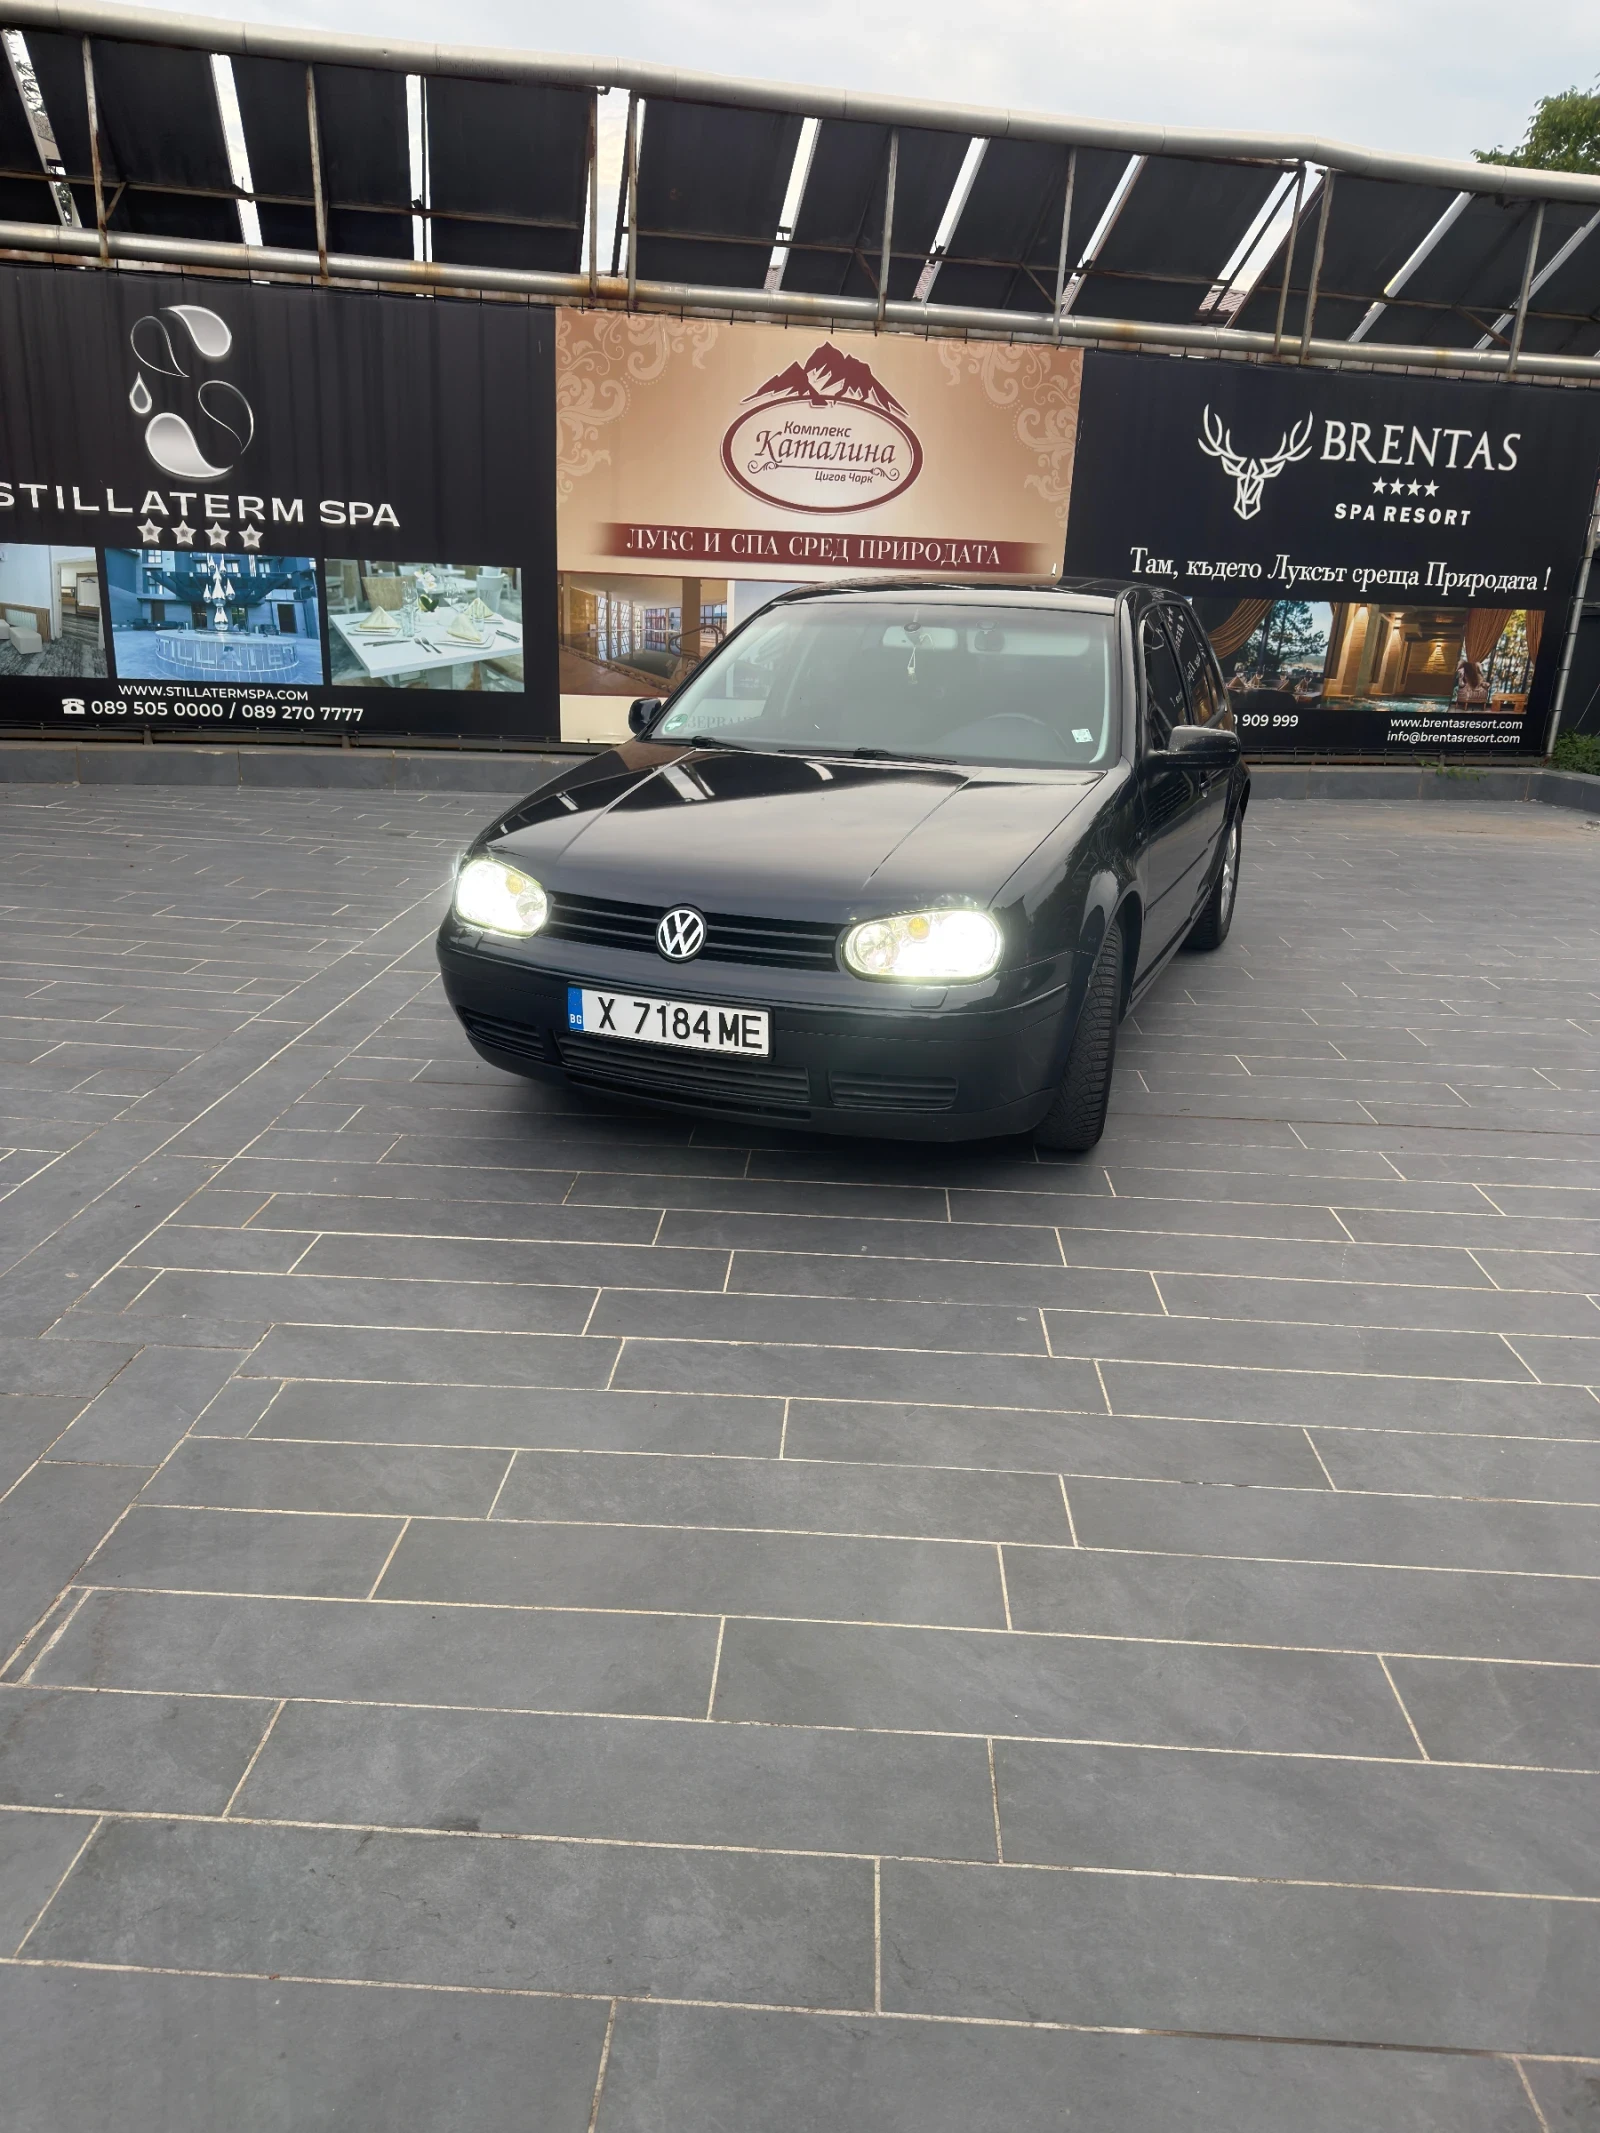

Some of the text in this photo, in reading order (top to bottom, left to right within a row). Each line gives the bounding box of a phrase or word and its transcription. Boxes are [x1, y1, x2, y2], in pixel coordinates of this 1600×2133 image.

[784, 421, 852, 438] Комплекс
[754, 430, 896, 463] Каталина
[1319, 419, 1521, 471] BRENTAS
[814, 471, 846, 483] Цигов
[319, 500, 401, 528] SPA
[1334, 503, 1471, 526] SPA RESORT
[626, 528, 1001, 566] ЛУКС И СПА СРЕД ПРИРОДАТА
[1130, 547, 1179, 579] Там,
[1185, 559, 1262, 579] където
[1267, 554, 1348, 589] Луксът
[1352, 567, 1420, 593] среща
[1424, 561, 1538, 597] Природата
[118, 684, 309, 701] WWW.STILLATERMSPA.COM
[91, 700, 128, 715] 089
[133, 701, 168, 716] 505
[173, 702, 224, 717] 0000
[241, 704, 277, 719] 089
[281, 705, 315, 720] 270
[319, 706, 364, 722] 7777
[1242, 714, 1269, 727] 909
[1272, 714, 1299, 727] 999
[1390, 717, 1523, 730] www.brentasresort.com
[1387, 730, 1521, 744] info@brentasresort.com
[569, 1013, 582, 1025] BG
